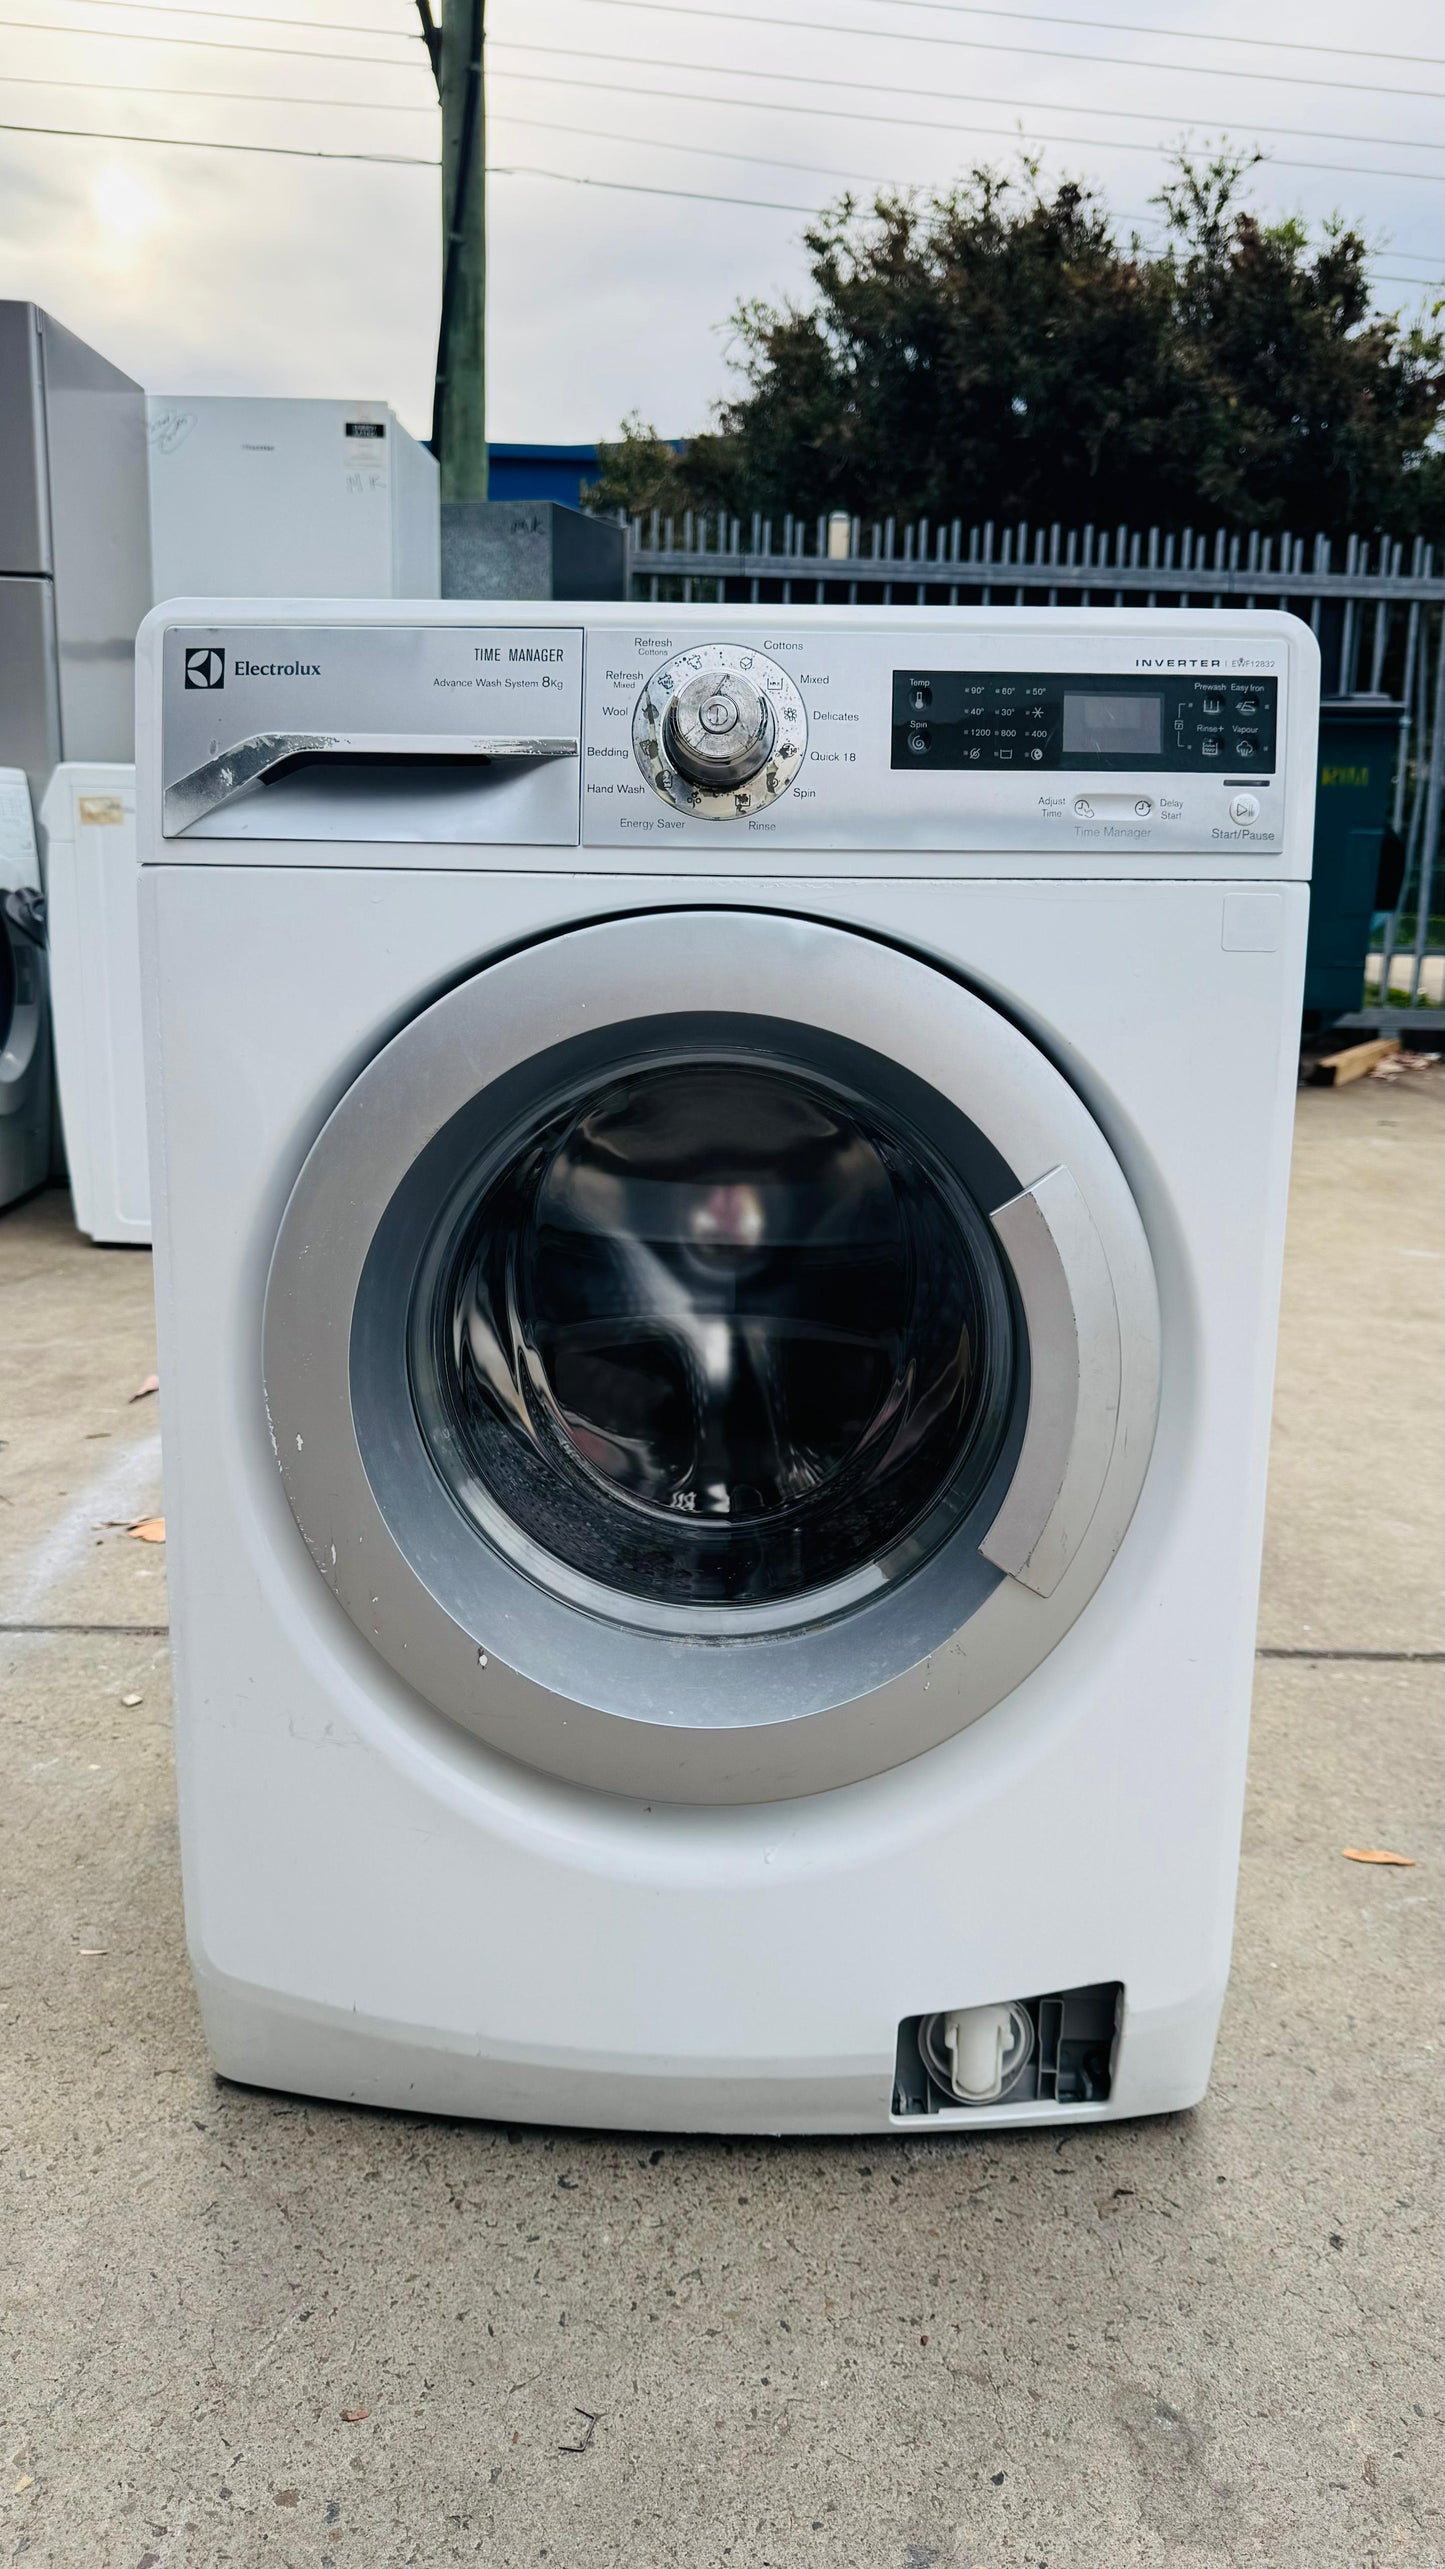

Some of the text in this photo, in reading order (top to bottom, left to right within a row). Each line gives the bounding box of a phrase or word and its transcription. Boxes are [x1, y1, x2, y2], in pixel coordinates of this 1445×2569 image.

[634, 637, 673, 648] Refresh
[763, 640, 804, 651] Cottons
[474, 647, 564, 662] TIME MANAGER
[638, 648, 668, 656] Cottons
[234, 660, 322, 677] Electrolux
[1135, 658, 1221, 668] INVERTER
[605, 670, 644, 681] Refresh
[800, 673, 830, 685] Mixed
[433, 675, 564, 692] Advance Wash System 8Kg
[613, 682, 636, 690] Mixed
[909, 678, 931, 688] Temp
[1194, 682, 1227, 691] Prewash
[1230, 683, 1265, 694] Easy Iron
[602, 706, 629, 717] Wool
[813, 710, 860, 722] Delicates
[910, 720, 928, 730] Spin
[1196, 724, 1225, 733] Rinse+
[1232, 725, 1259, 735] Vapour
[971, 728, 991, 738] 1200
[1000, 729, 1017, 738] 800
[1031, 730, 1048, 739] 400
[587, 746, 629, 760] Bedding
[810, 750, 857, 762] Quick 18
[587, 784, 646, 794] Hand Wash
[793, 787, 816, 799] Spin
[1037, 796, 1066, 807] Adjust
[1159, 798, 1184, 810] Delay
[1041, 808, 1063, 818] Time
[1160, 810, 1183, 821] Start
[620, 818, 686, 831] Energy Saver
[748, 820, 777, 832] Rinse
[1074, 826, 1152, 841] Time Manager
[1211, 828, 1275, 842] Start/Pause
